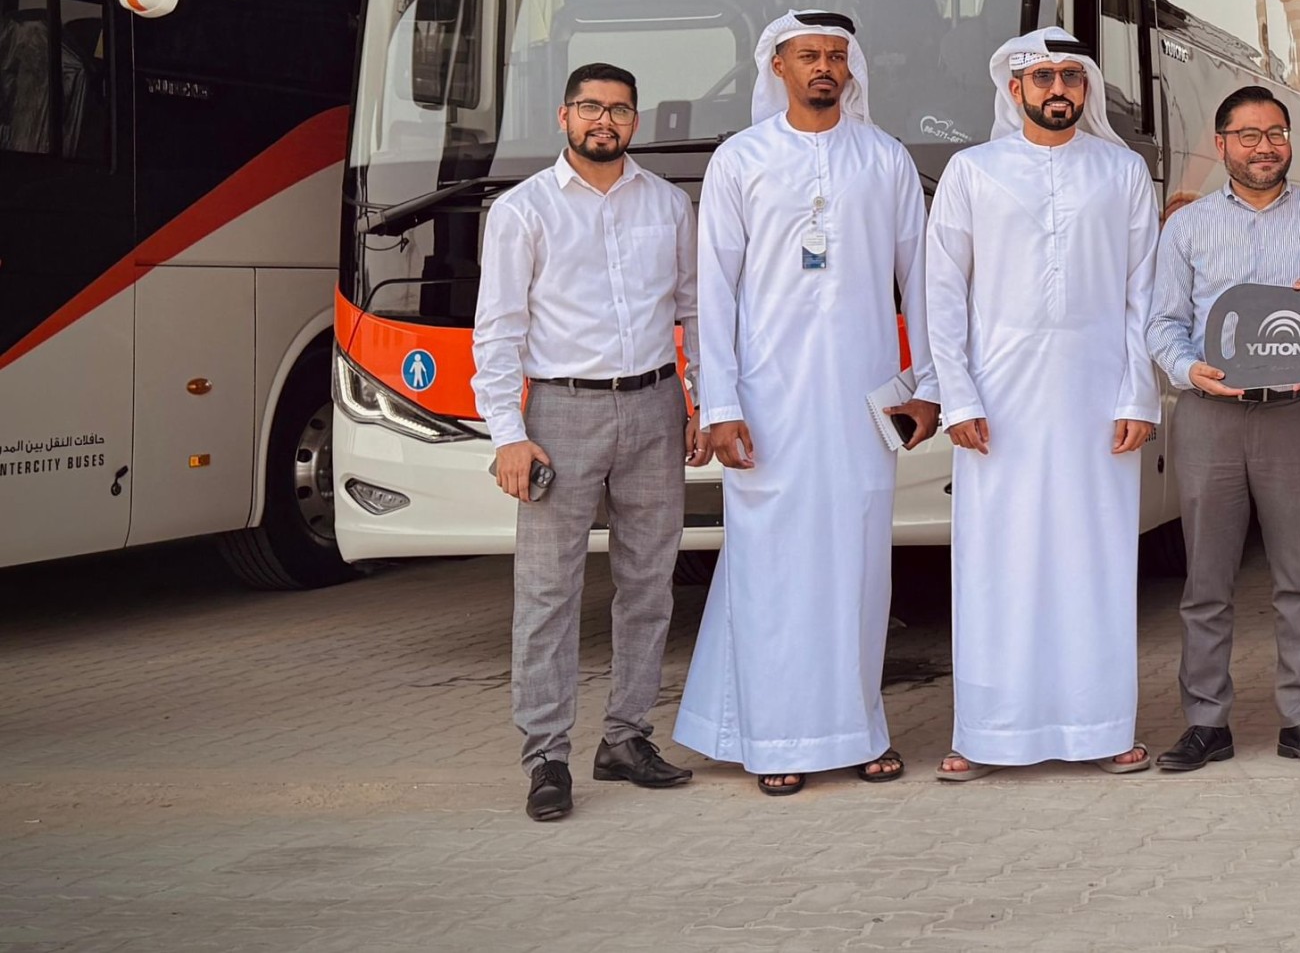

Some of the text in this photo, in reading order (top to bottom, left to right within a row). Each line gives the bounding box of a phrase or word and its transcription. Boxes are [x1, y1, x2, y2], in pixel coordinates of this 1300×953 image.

[0, 433, 105, 455] حافلات النقل بين المد
[67, 453, 105, 469] BUSES
